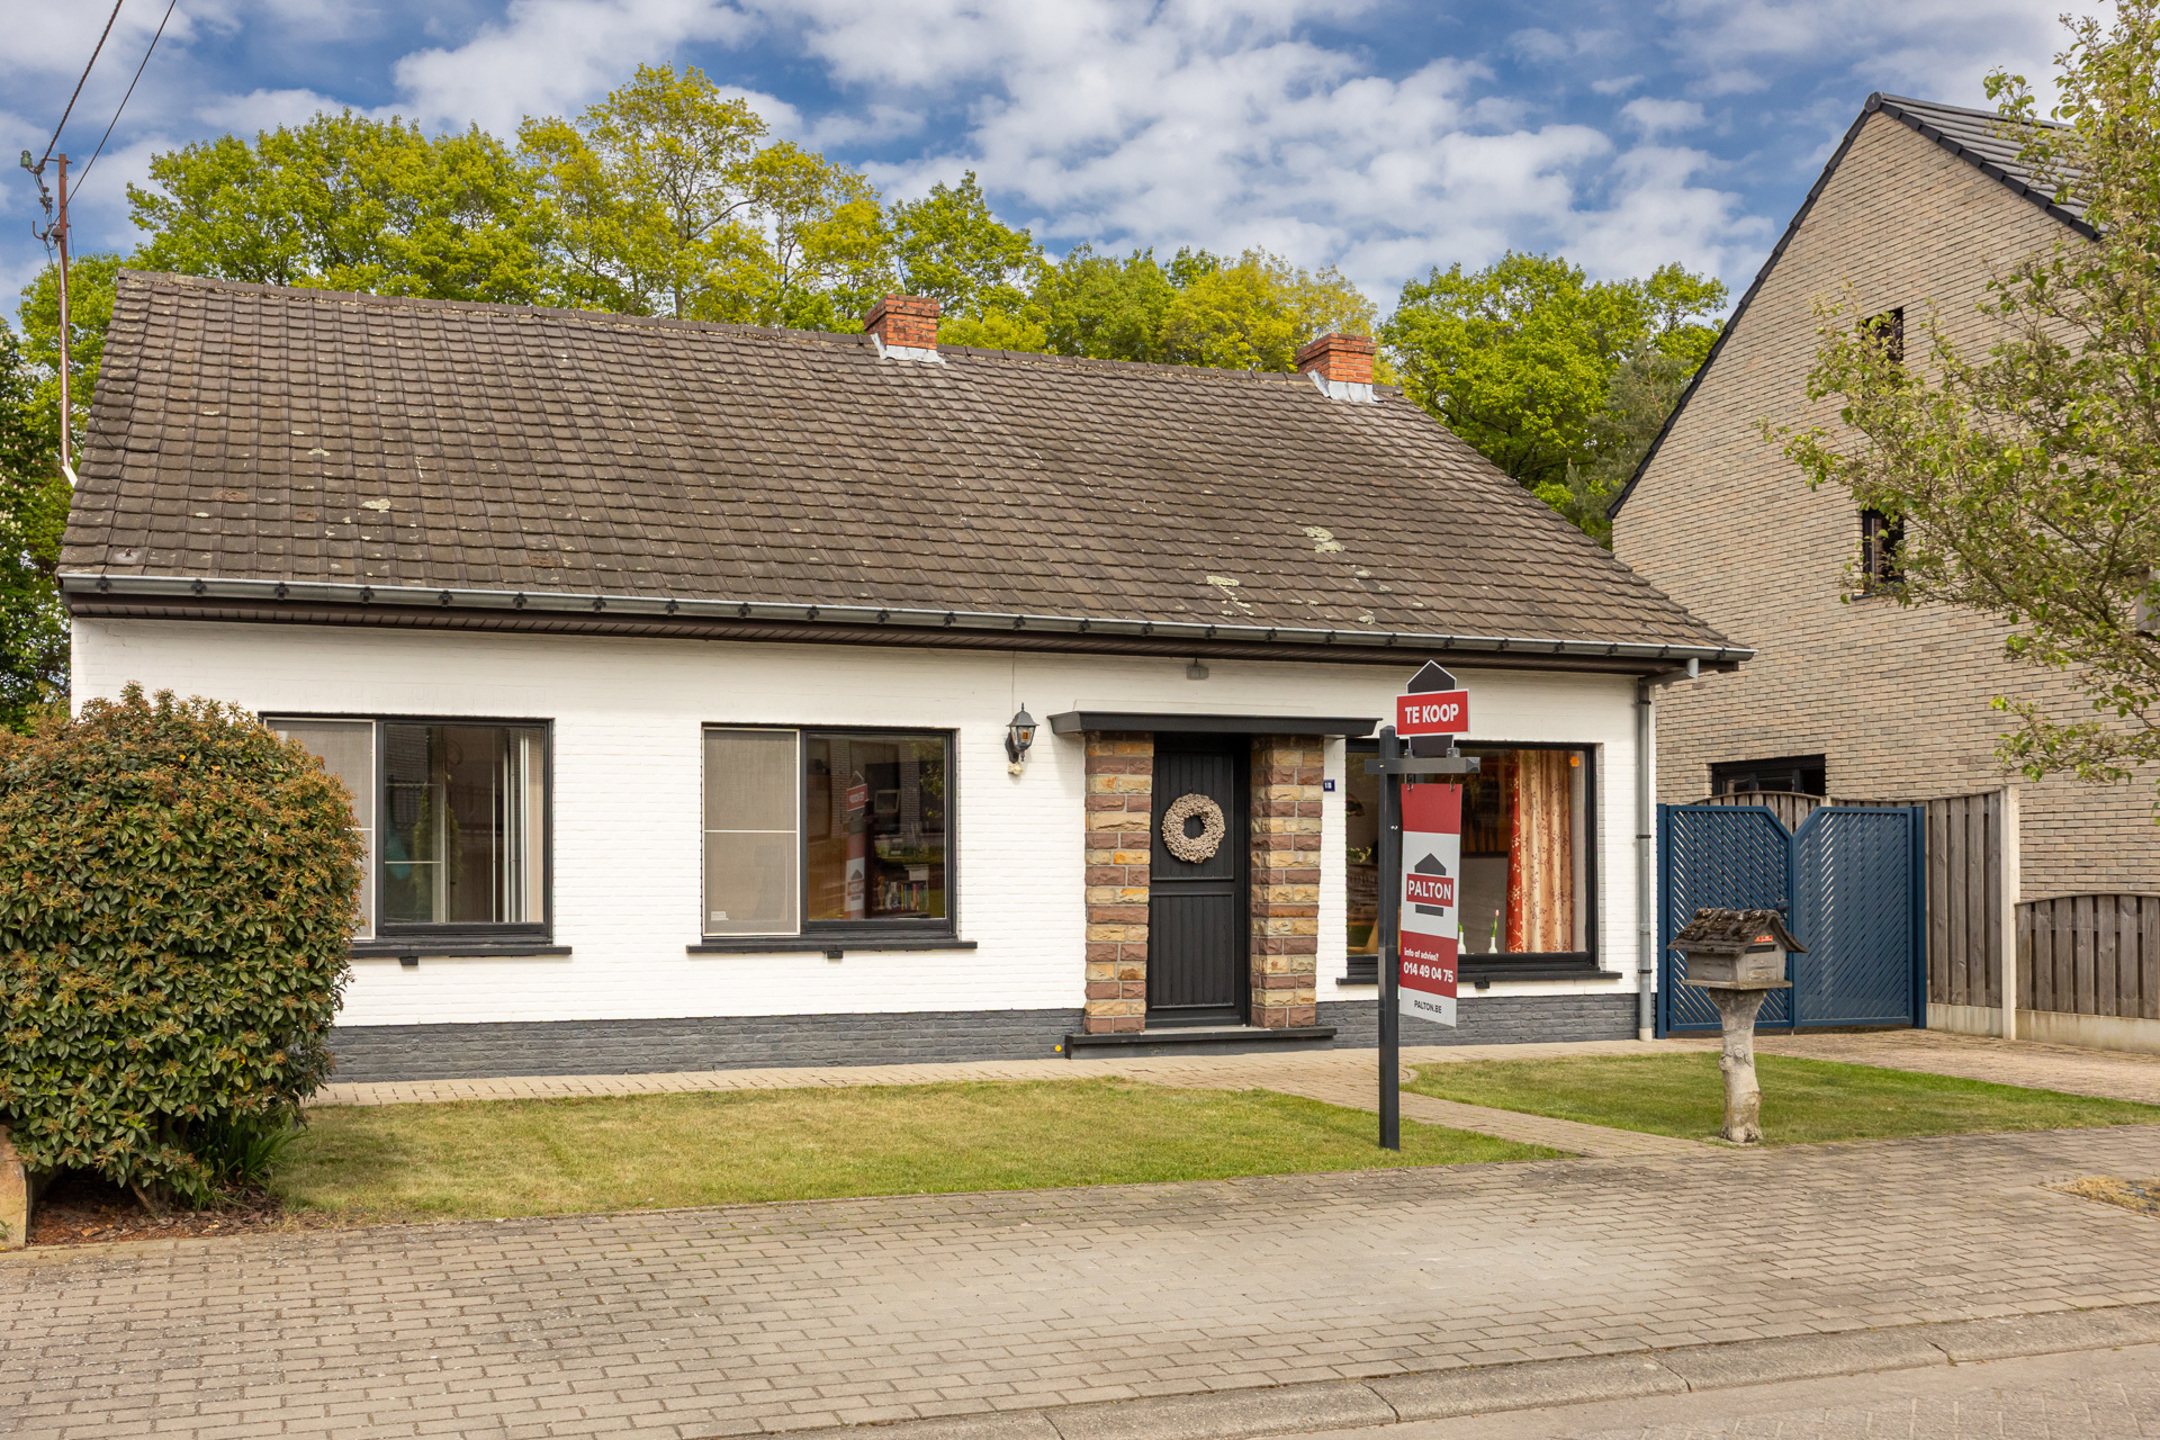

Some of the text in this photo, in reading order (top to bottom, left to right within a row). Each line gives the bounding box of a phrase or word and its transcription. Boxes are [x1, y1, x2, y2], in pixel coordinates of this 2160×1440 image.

[1405, 703, 1459, 724] TE KOOP
[1408, 880, 1451, 900] PALTON
[1403, 961, 1454, 983] 014 49 04 75
[1414, 999, 1442, 1014] PALTON.BE
